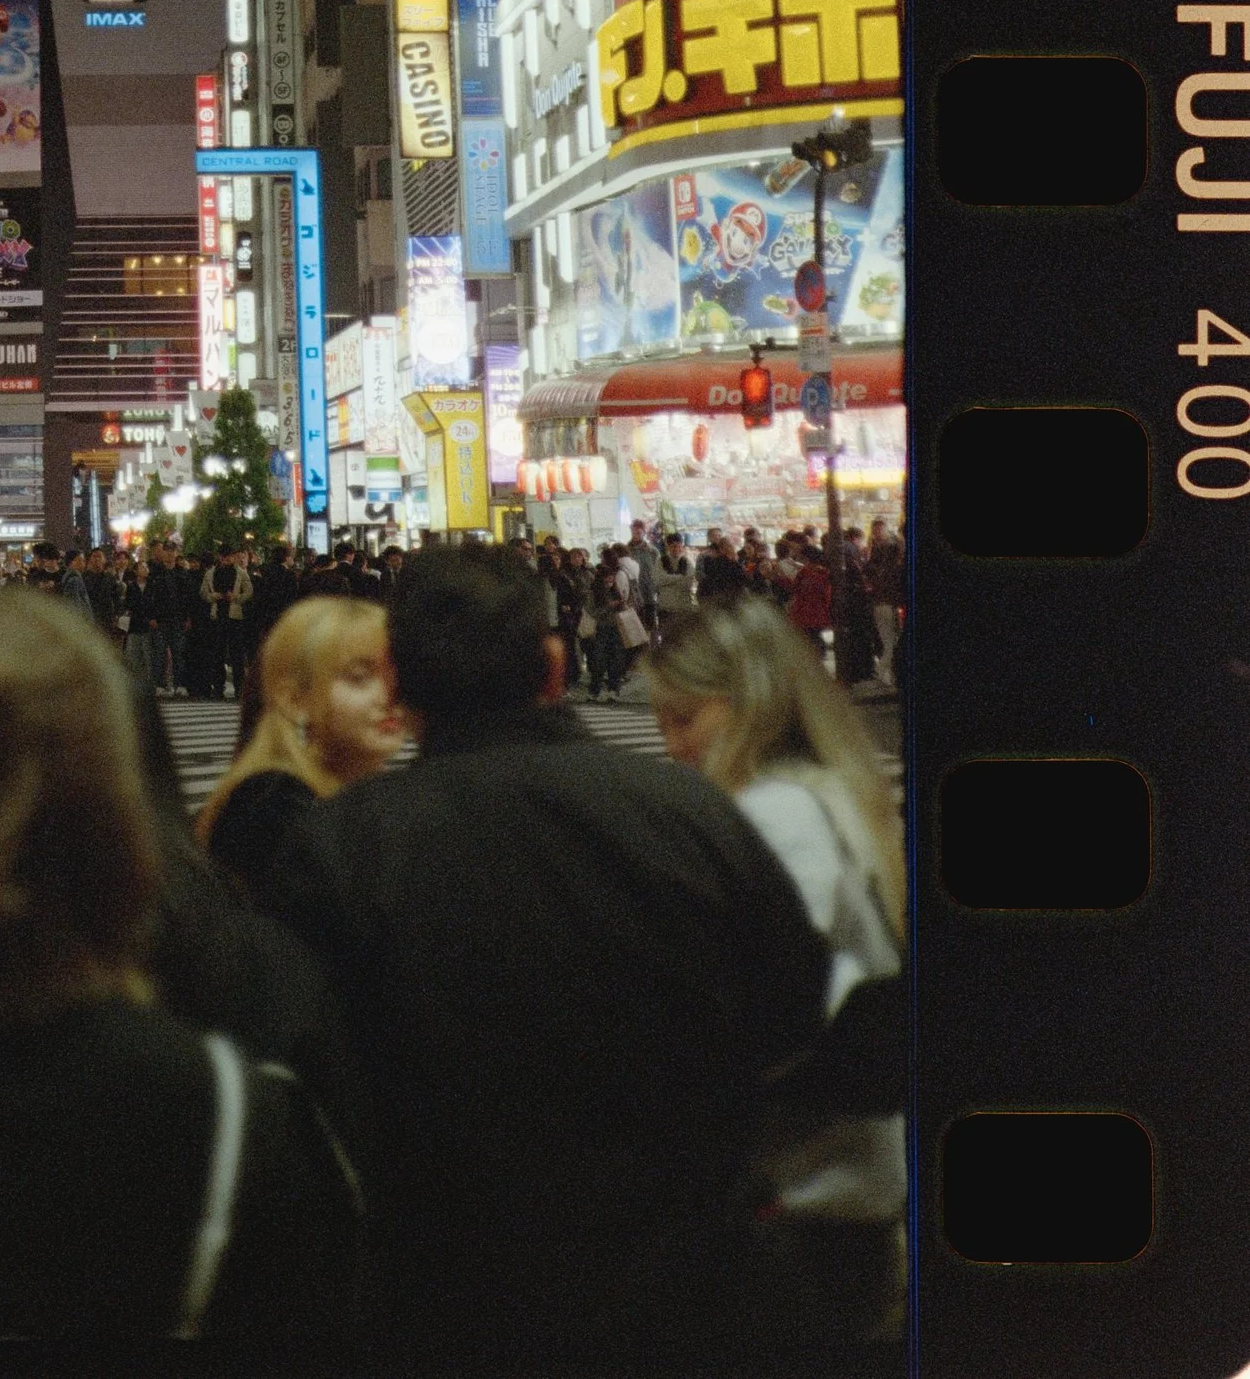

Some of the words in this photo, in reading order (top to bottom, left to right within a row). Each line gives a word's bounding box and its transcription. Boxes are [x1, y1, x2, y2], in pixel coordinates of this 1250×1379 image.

[85, 11, 144, 27] IMAX
[400, 40, 451, 149] CASINO
[1174, 4, 1250, 232] FUJI
[202, 157, 258, 167] CENTRAL
[264, 156, 299, 166] ROAD
[301, 222, 319, 443] ゴジラロード
[433, 399, 481, 412] カラオケ
[1176, 309, 1250, 500] 400
